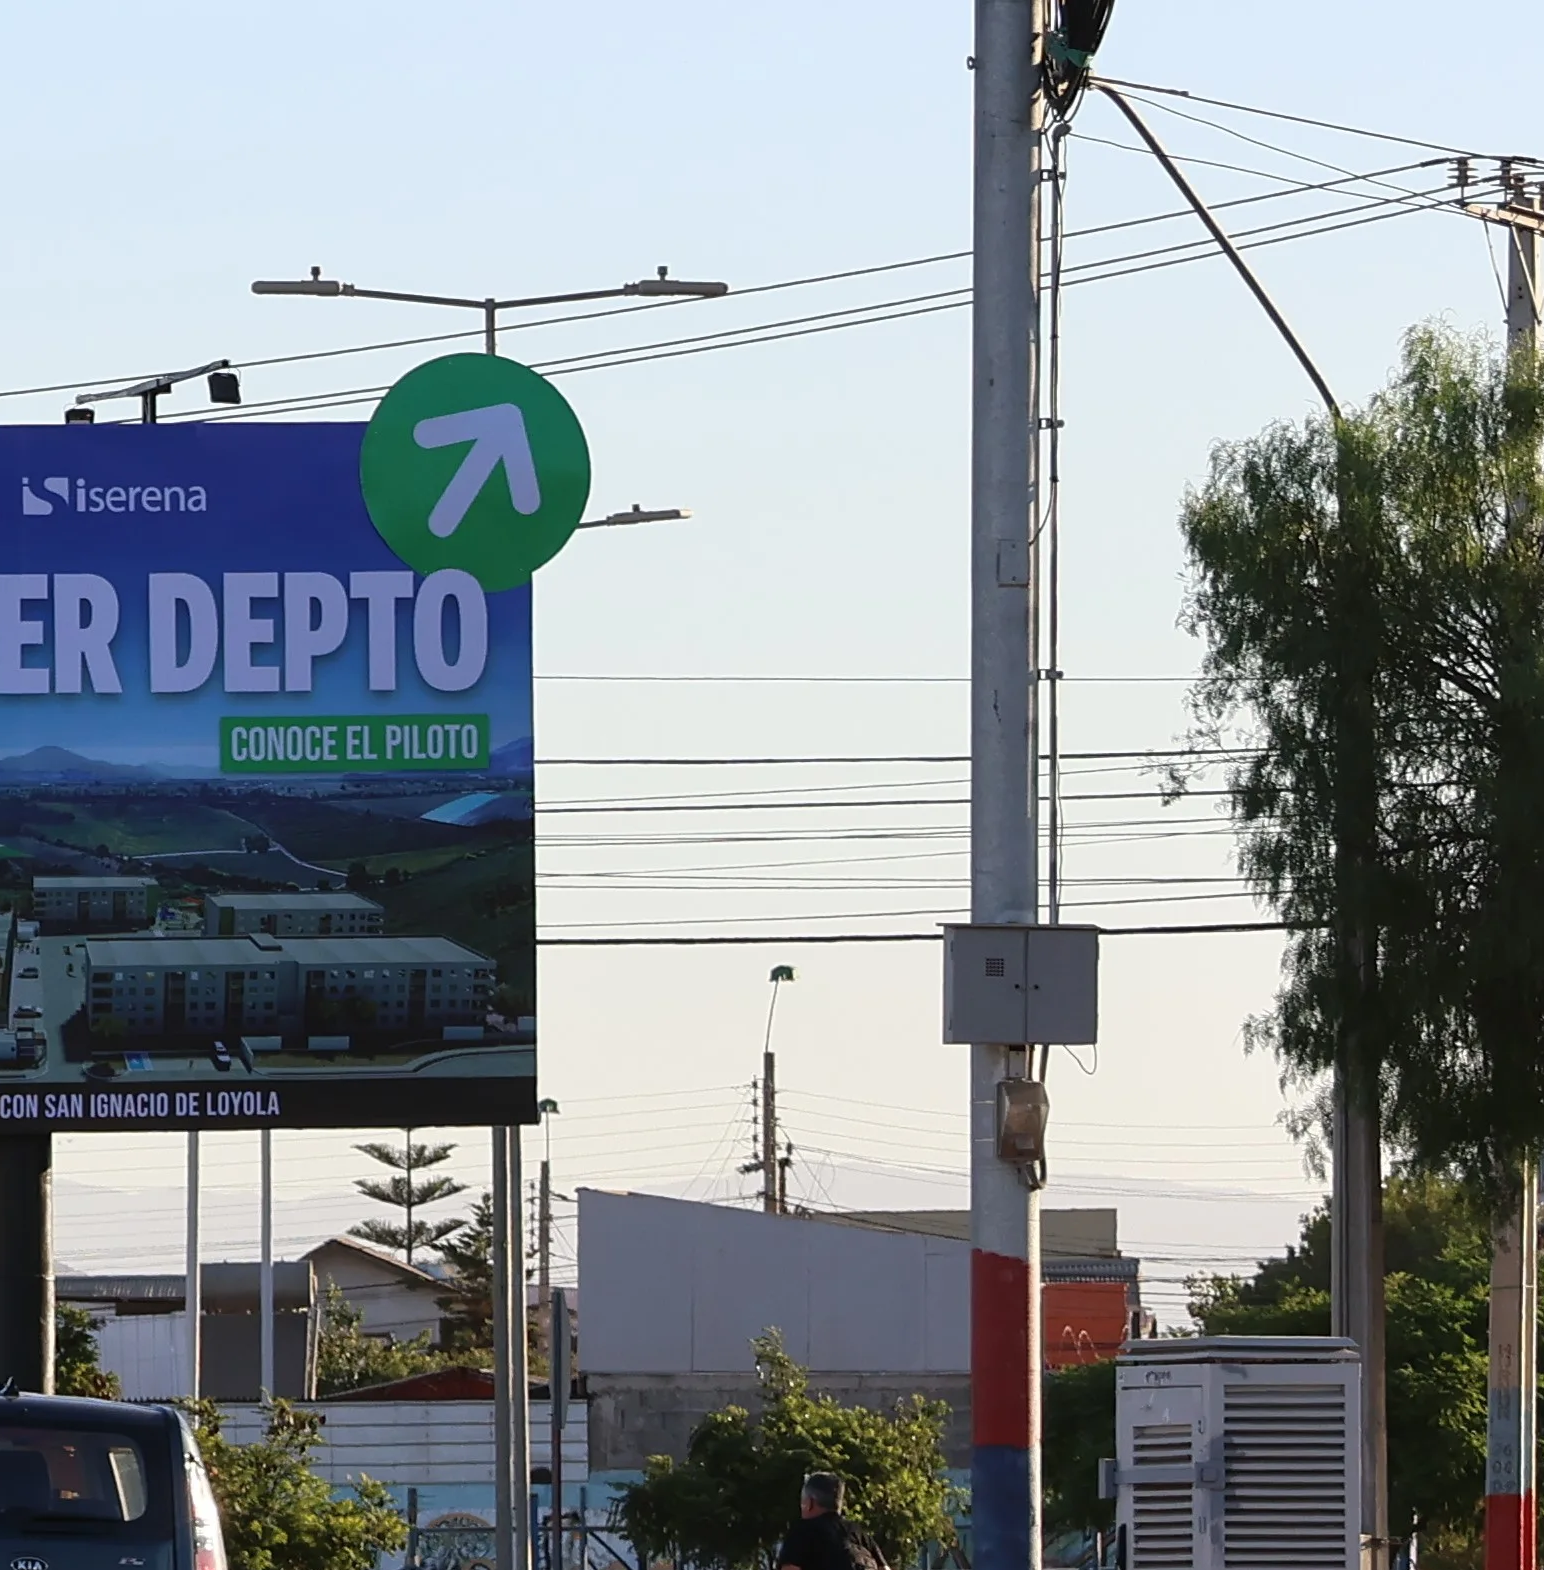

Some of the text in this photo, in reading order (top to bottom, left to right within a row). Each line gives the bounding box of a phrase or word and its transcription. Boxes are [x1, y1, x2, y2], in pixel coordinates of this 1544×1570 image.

[76, 477, 208, 513] iserena
[148, 568, 489, 694] DEPTO
[231, 723, 479, 762] CONOCE EL PILOTO
[44, 1093, 84, 1118] SAN
[90, 1092, 169, 1118] IGNACIO
[175, 1092, 200, 1116] DE
[206, 1091, 281, 1116] LOYOLA
[17, 1560, 42, 1570] KIA
